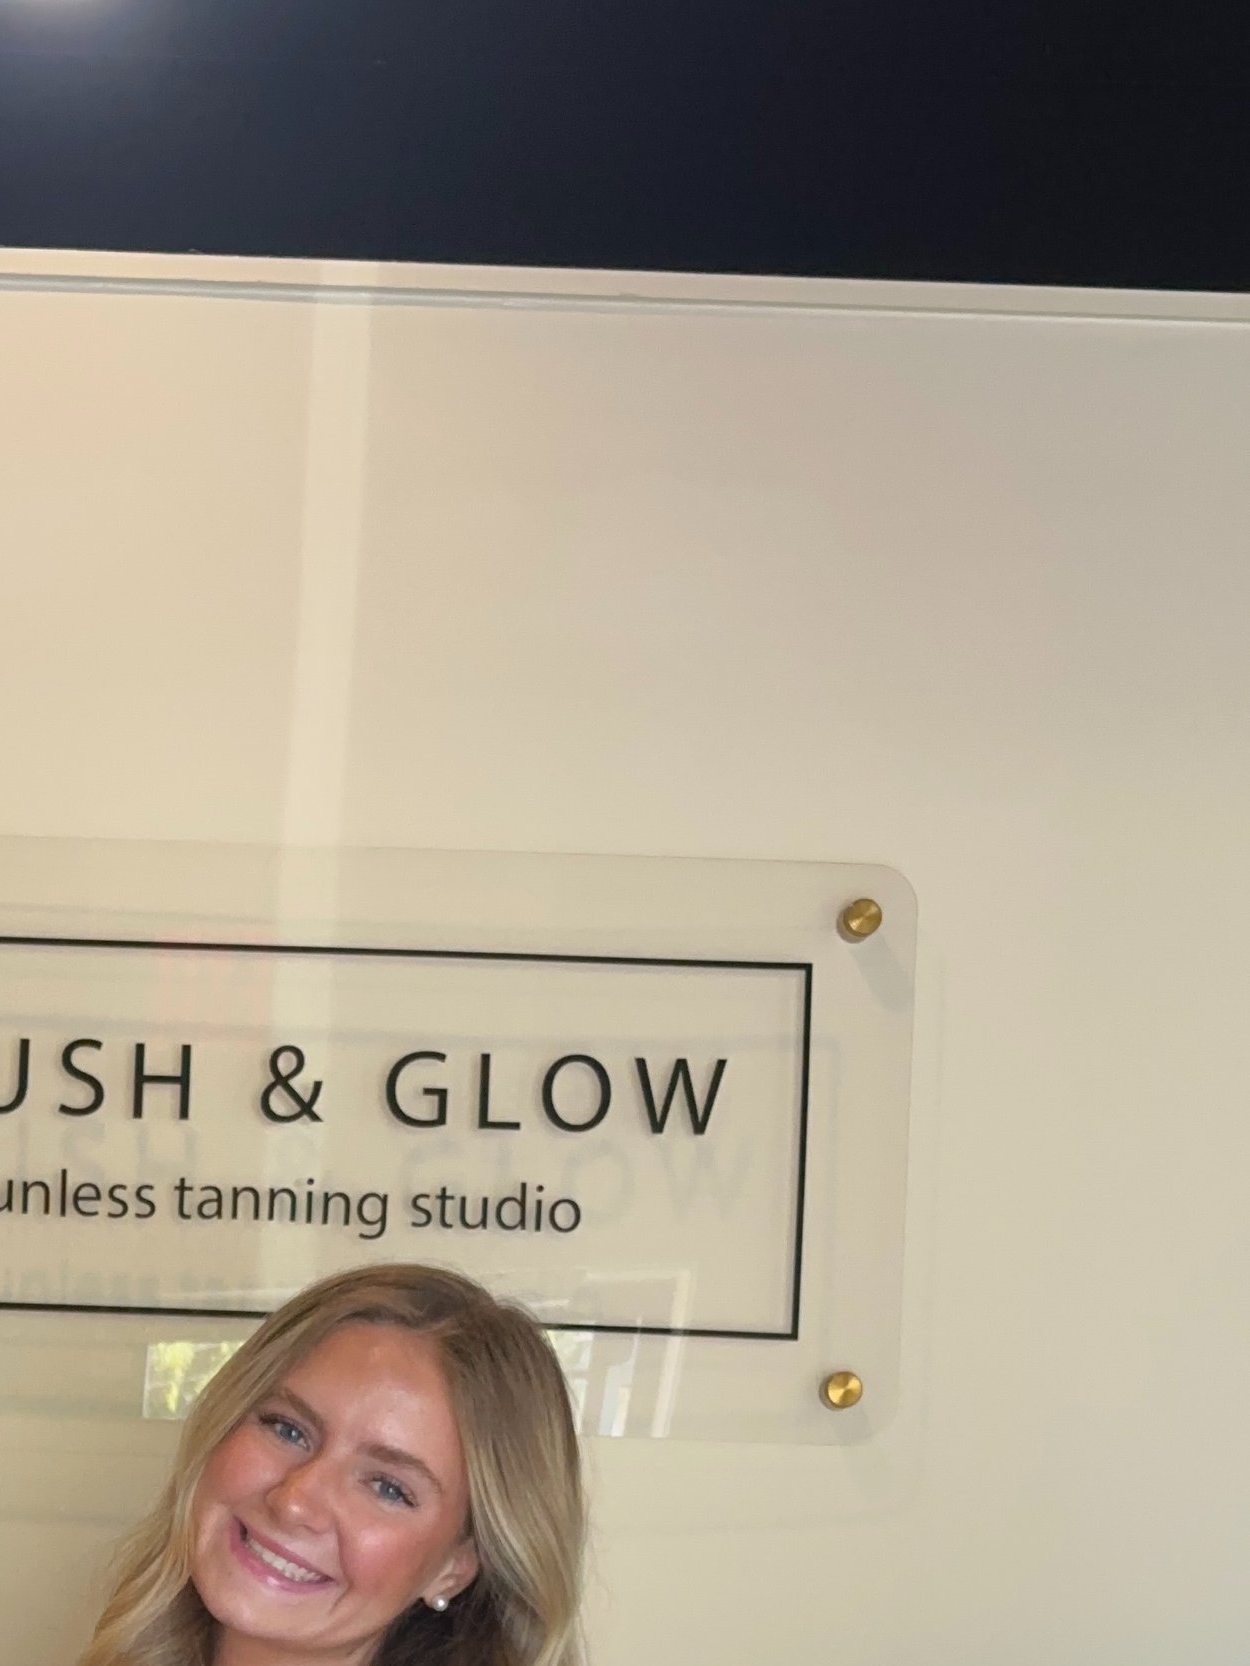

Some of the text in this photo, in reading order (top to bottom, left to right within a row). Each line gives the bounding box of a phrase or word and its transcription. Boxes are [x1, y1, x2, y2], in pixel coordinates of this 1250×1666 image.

[259, 1044, 324, 1124] &
[384, 1050, 728, 1136] GLOW
[174, 1176, 388, 1241] tanning
[412, 1181, 582, 1235] studio
